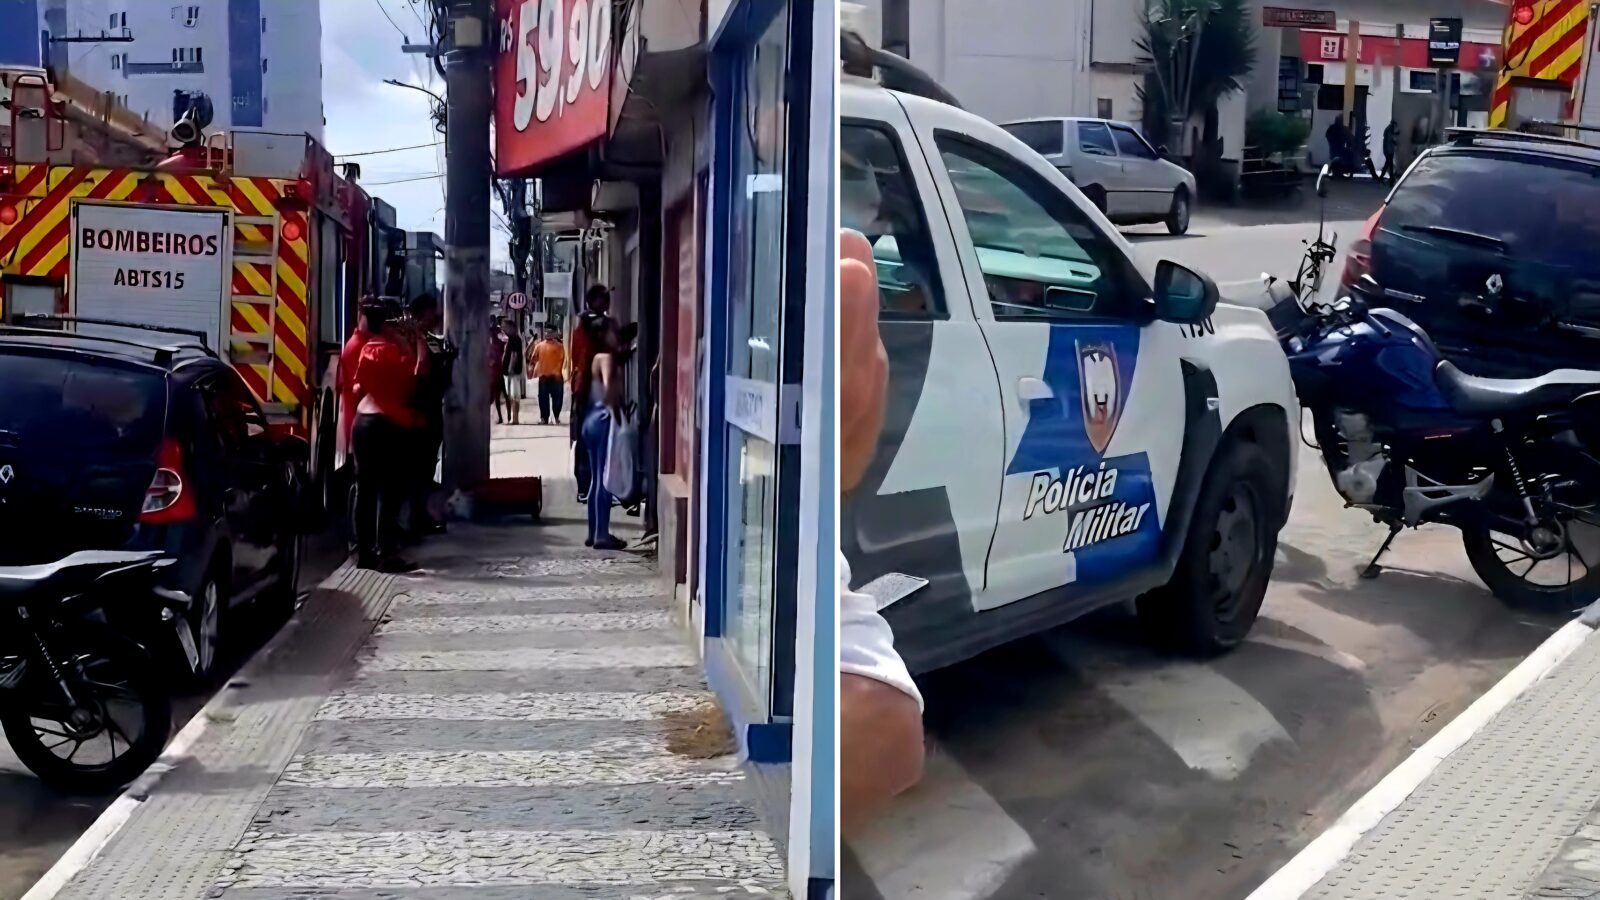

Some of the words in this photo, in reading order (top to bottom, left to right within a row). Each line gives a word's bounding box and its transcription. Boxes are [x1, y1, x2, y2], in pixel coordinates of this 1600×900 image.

[514, 0, 612, 132] 59,90
[82, 228, 218, 256] BOMBEIROS
[113, 268, 185, 290] ABTS15
[1023, 462, 1118, 520] Polícia
[1063, 502, 1151, 553] Militar
